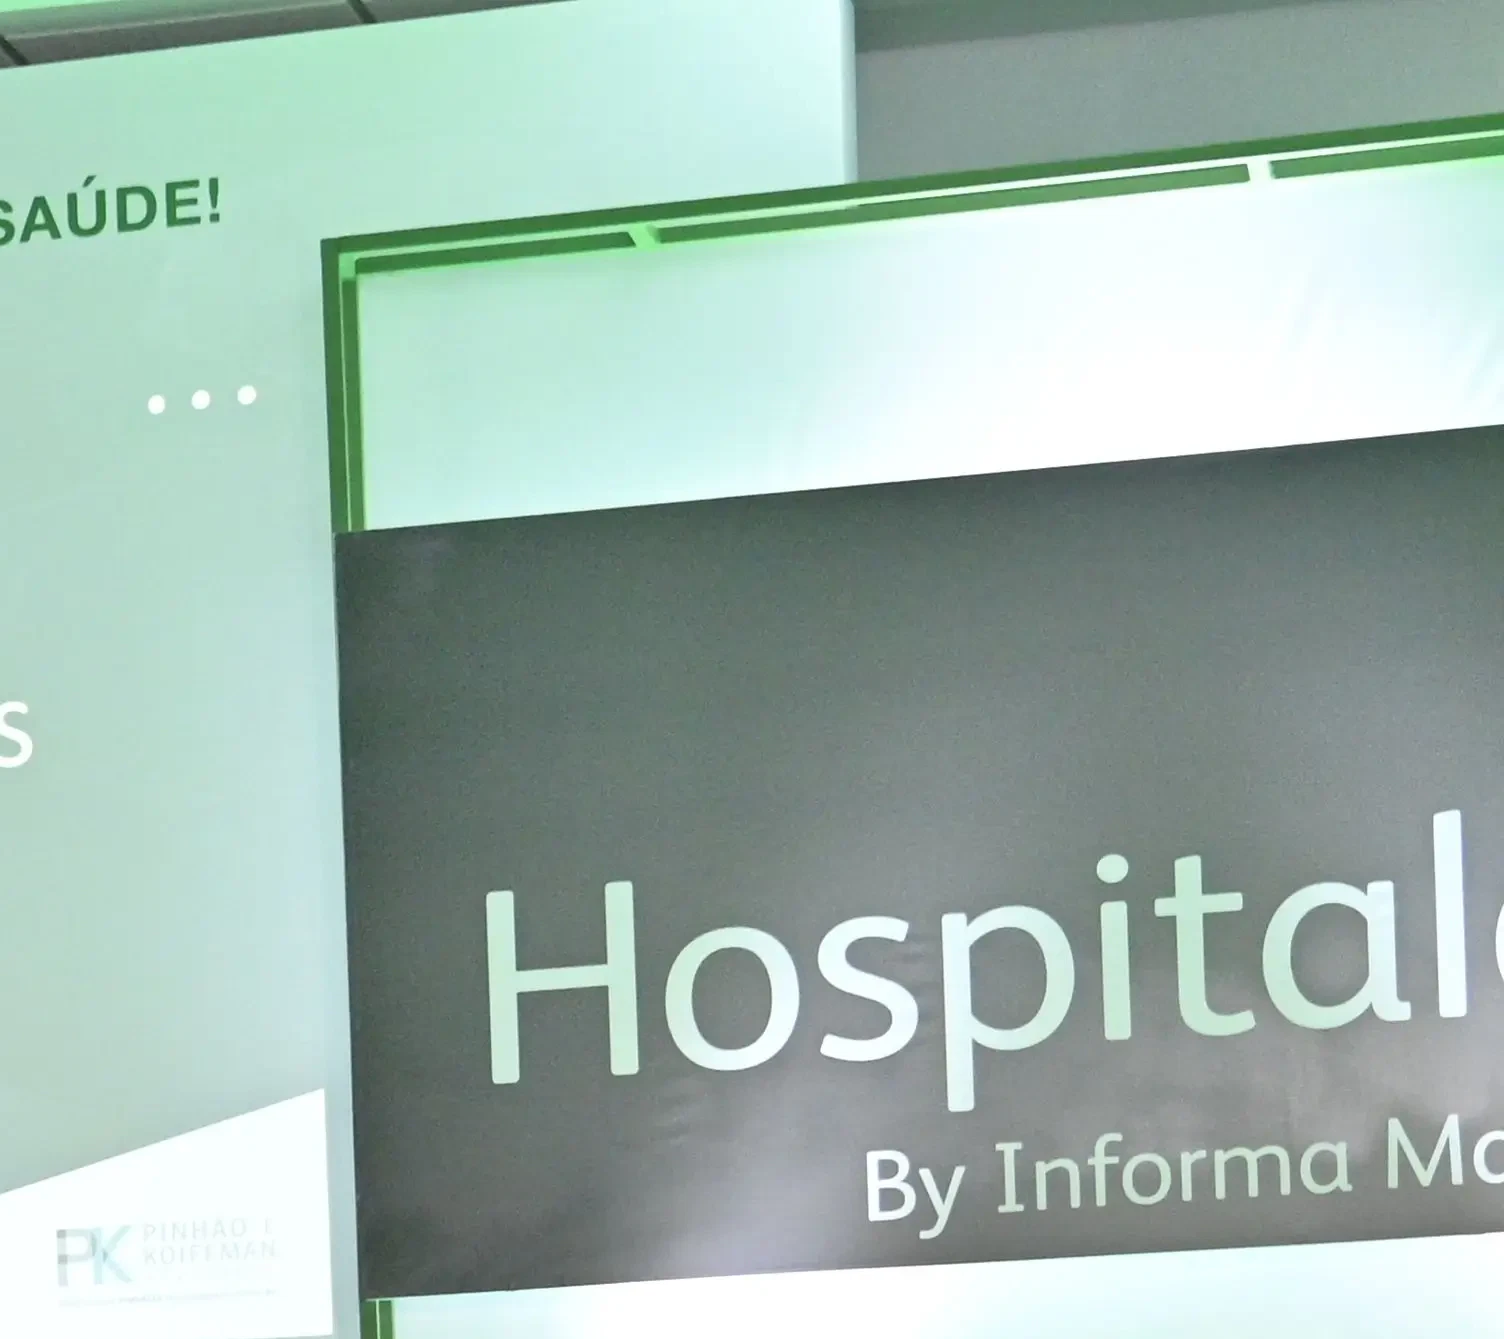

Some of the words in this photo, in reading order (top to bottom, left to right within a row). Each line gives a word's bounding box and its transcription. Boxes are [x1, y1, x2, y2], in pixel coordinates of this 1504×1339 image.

[486, 809, 1504, 1112] Hospital
[865, 1149, 967, 1239] By
[995, 1132, 1353, 1214] Informa
